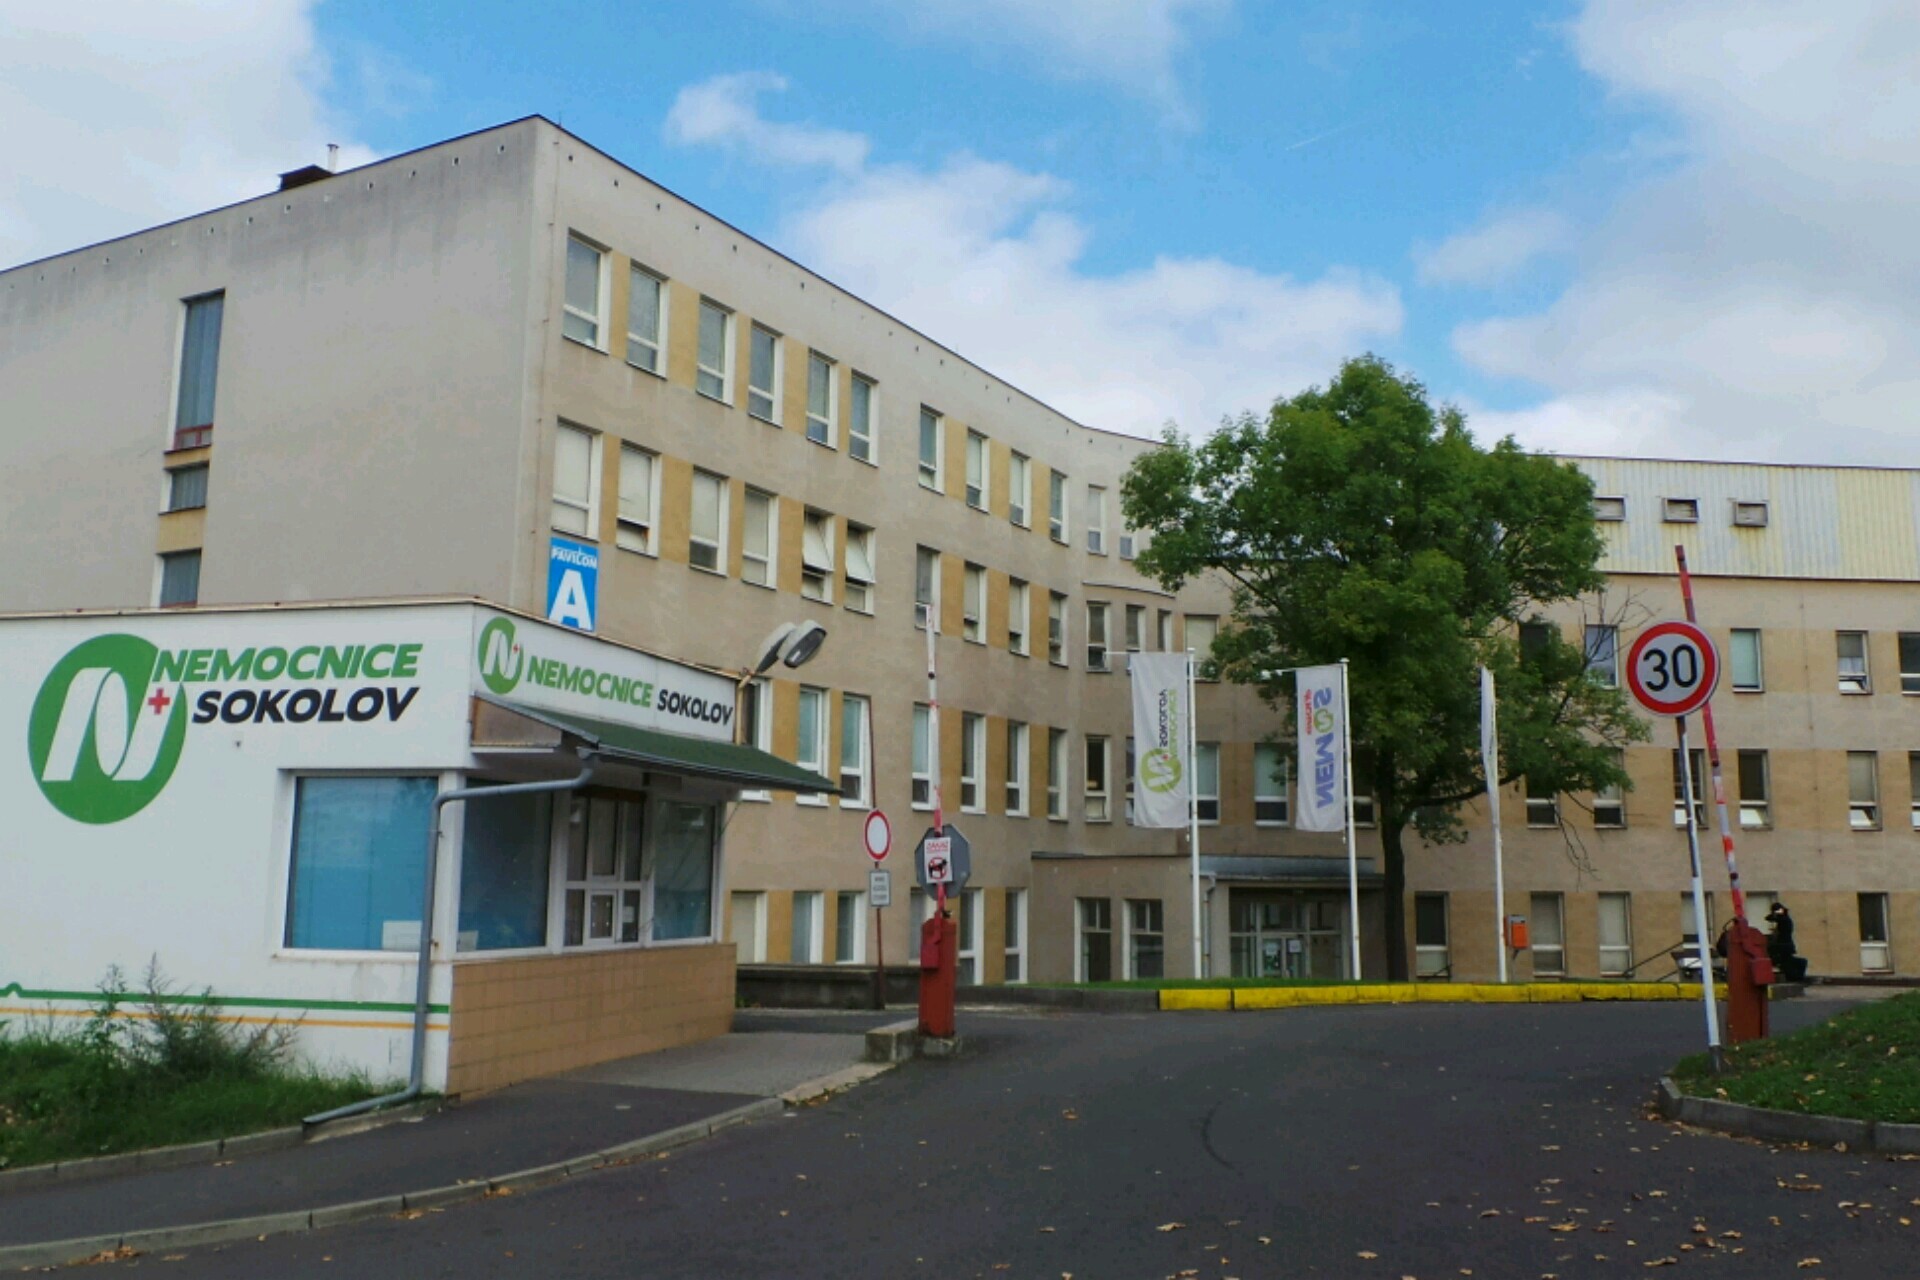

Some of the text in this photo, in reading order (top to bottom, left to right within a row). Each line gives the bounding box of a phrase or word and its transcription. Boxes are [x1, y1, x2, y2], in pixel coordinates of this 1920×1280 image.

[551, 546, 598, 569] PAVILON
[548, 569, 593, 632] A
[152, 643, 424, 683] NEMOCNICE
[1643, 644, 1697, 692] 30
[192, 686, 420, 725] SOKOLOV
[526, 655, 734, 727] NEMOCNICE SOKOLOV
